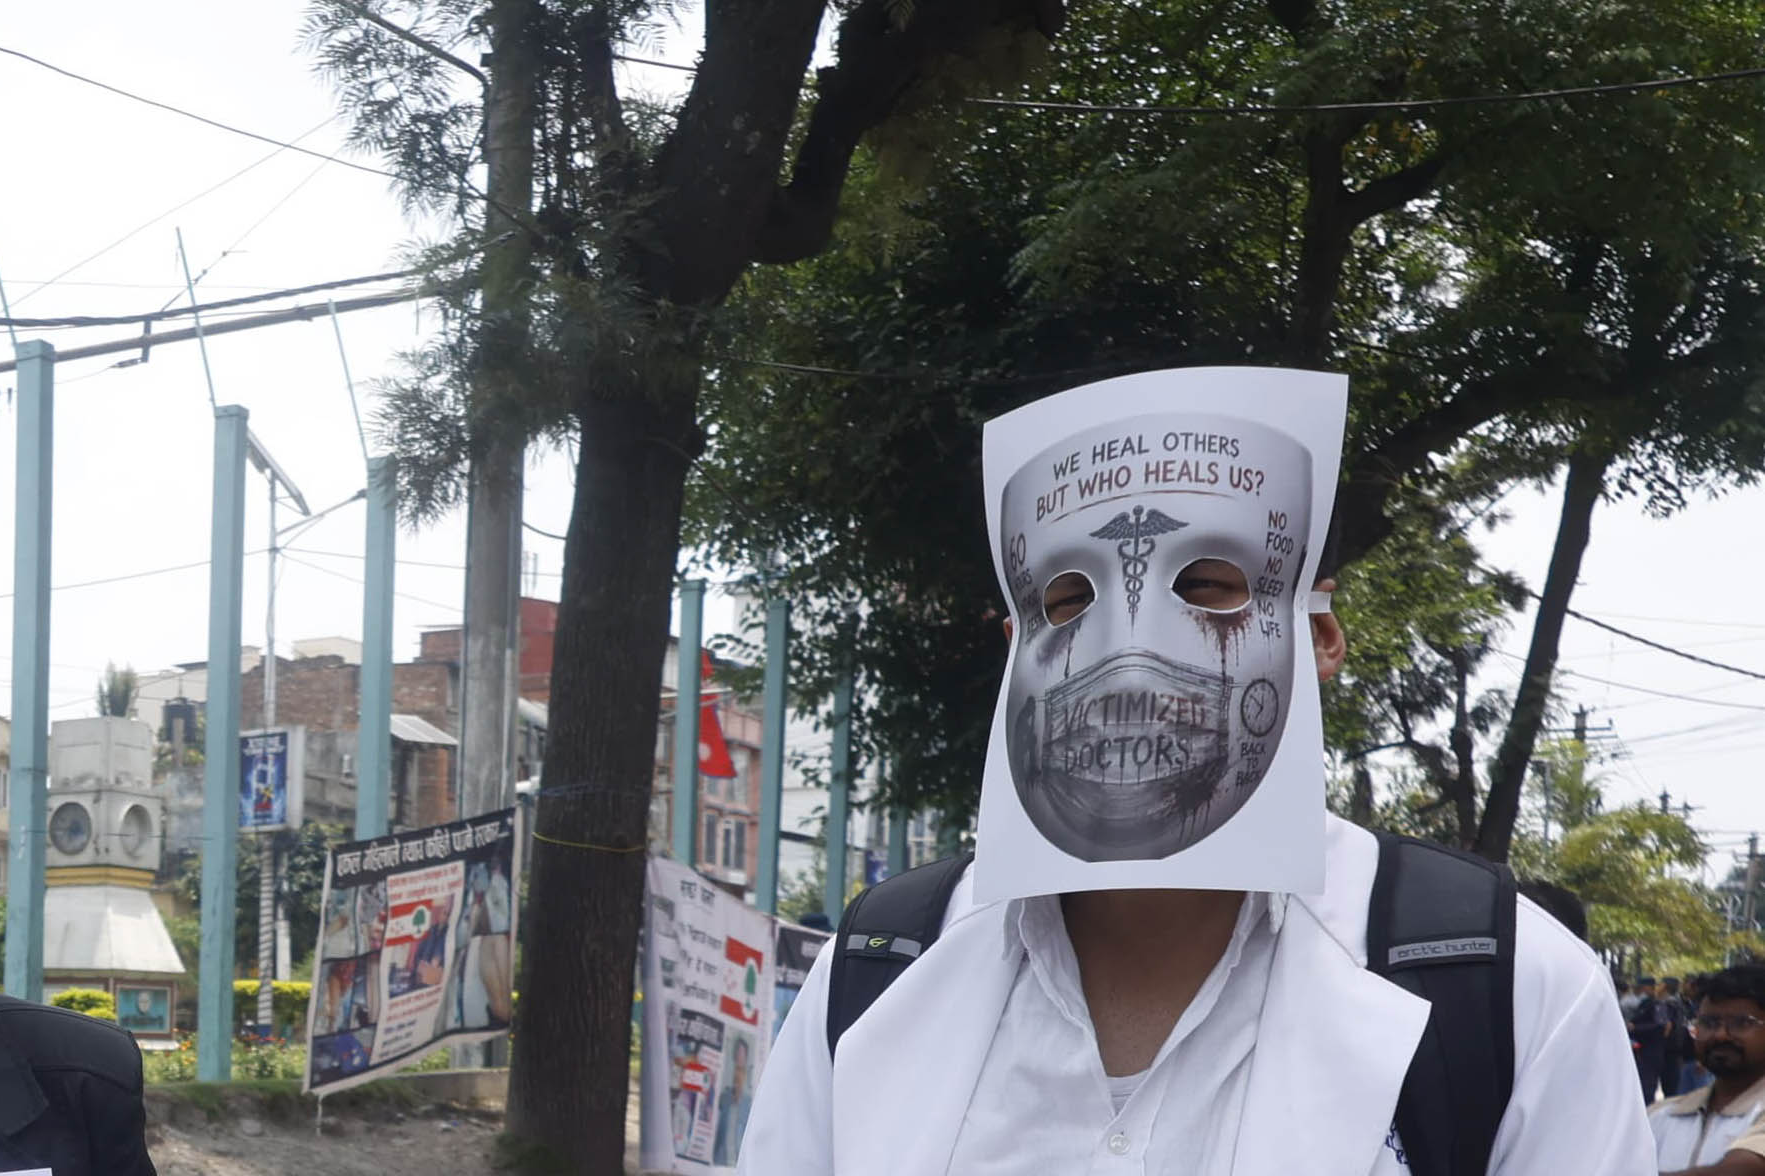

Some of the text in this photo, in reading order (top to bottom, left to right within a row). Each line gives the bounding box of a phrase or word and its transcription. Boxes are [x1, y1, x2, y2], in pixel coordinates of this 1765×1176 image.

[1053, 431, 1240, 481] WE HEAL OTHERS
[1036, 459, 1265, 522] BUT WHO HEALS US?
[1268, 509, 1288, 531] NO
[1010, 532, 1027, 571] 60
[1265, 531, 1294, 555] FOOD
[1264, 557, 1284, 585] NO
[1254, 575, 1285, 598] SLEEP
[1257, 599, 1275, 618] NO
[1259, 619, 1282, 640] LIFE
[1064, 690, 1207, 734] VICTIMIZED
[1064, 735, 1192, 774] DOCTORS
[1241, 742, 1267, 756] BACK
[1246, 757, 1260, 769] TO
[1445, 941, 1491, 953] hunter
